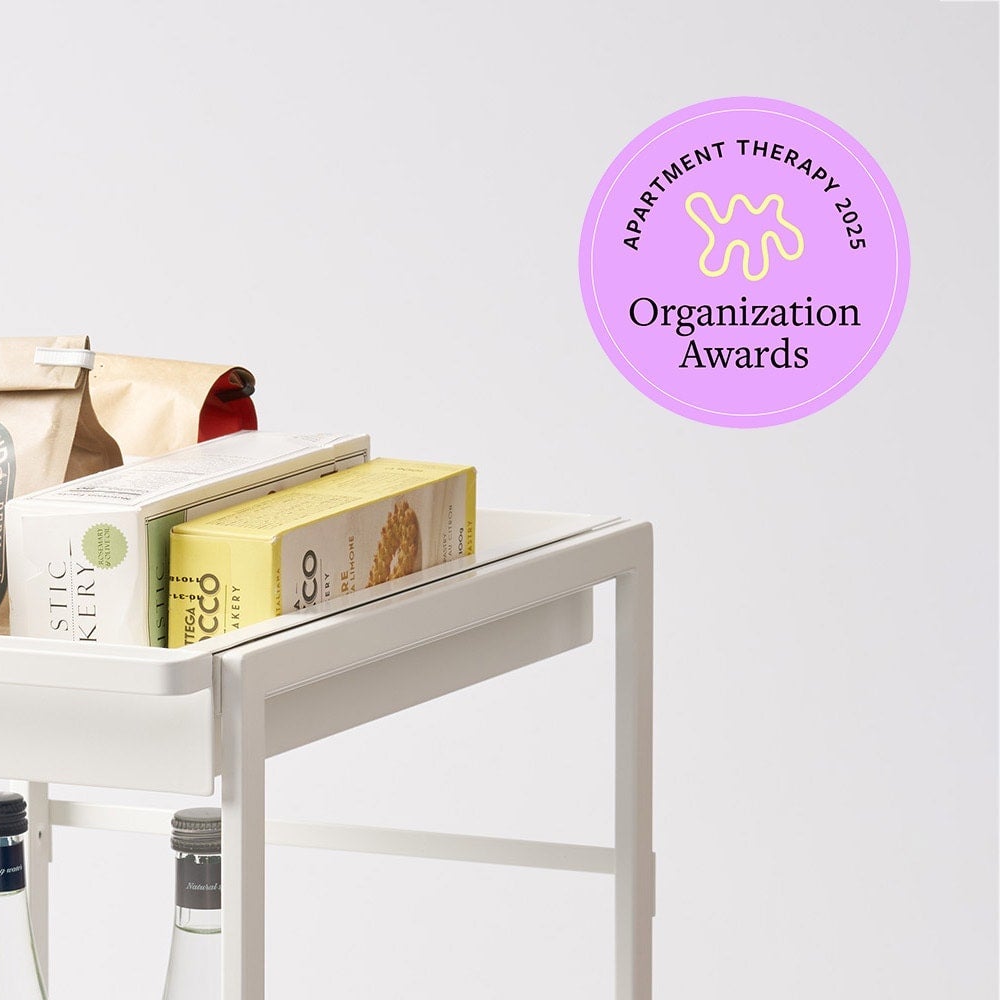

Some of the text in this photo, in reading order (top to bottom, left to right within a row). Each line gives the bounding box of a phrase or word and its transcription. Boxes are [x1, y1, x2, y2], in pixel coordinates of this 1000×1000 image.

[48, 562, 68, 631] STIC
[76, 562, 96, 641] KERY
[156, 562, 165, 641] ISTIC
[185, 608, 196, 645] TTEGA
[232, 586, 240, 629] AKERY
